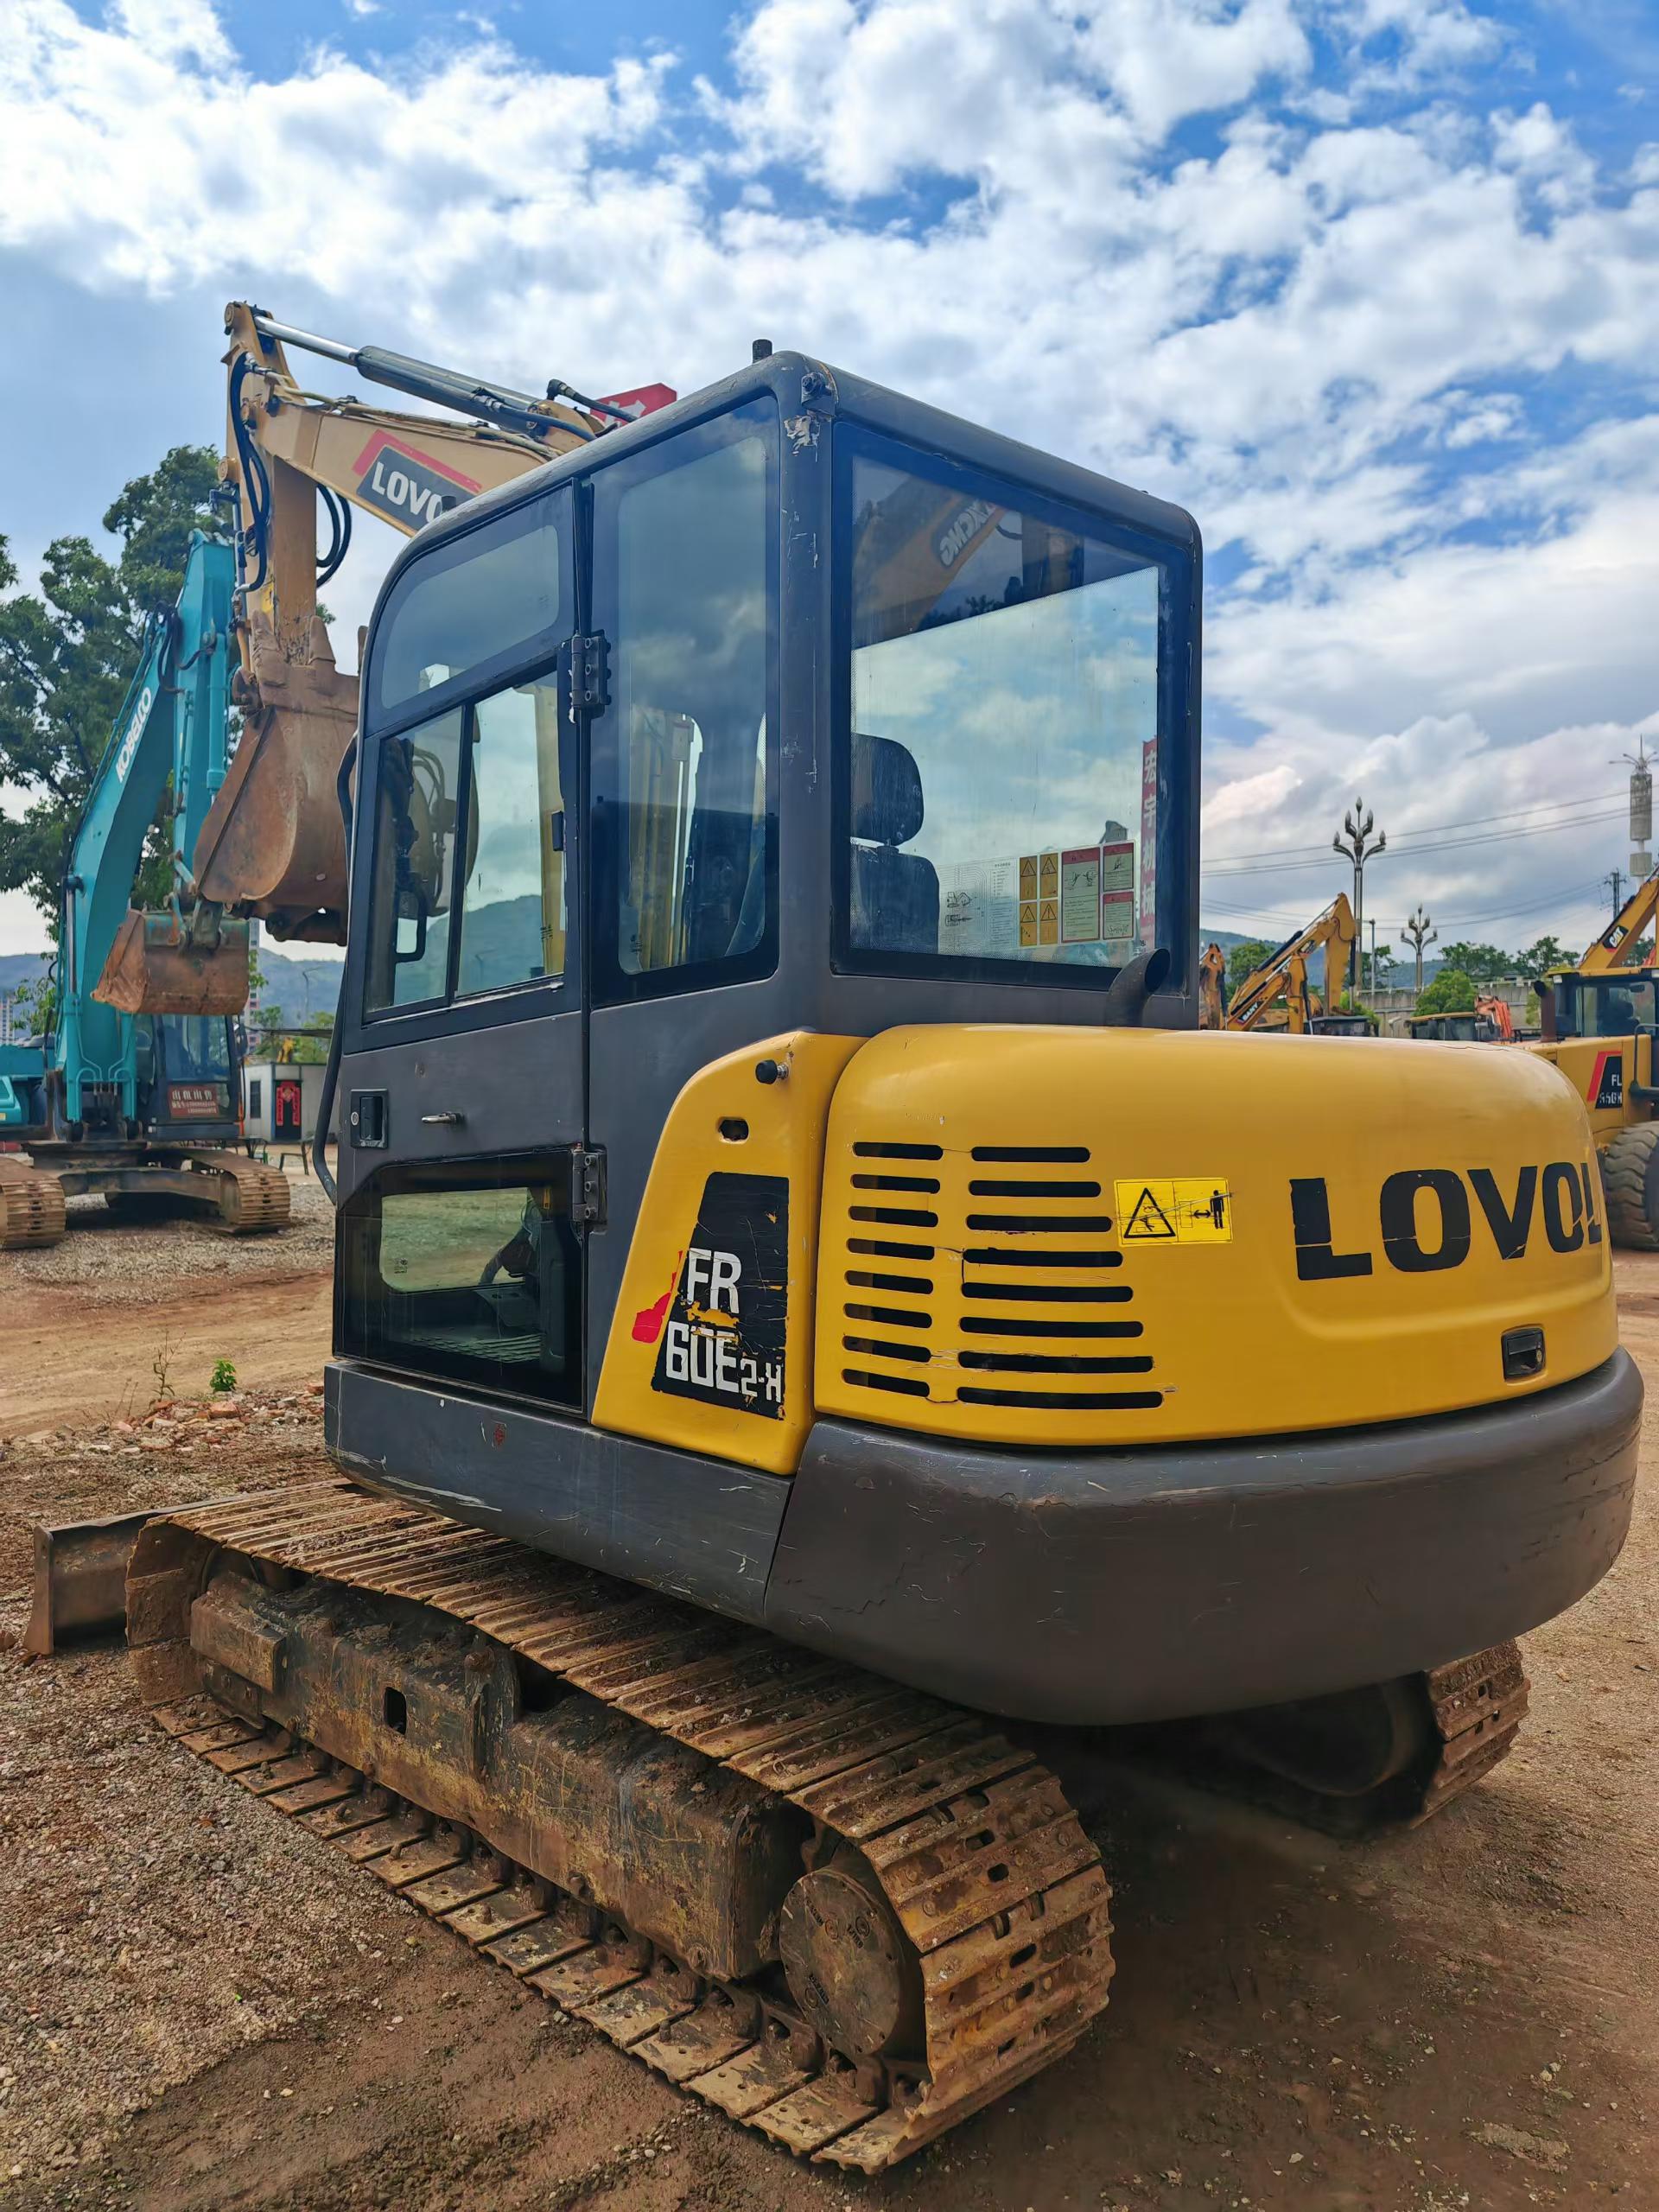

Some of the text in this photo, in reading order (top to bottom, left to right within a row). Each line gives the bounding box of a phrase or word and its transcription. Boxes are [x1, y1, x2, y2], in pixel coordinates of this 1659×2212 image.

[372, 461, 443, 524] LOVO
[116, 687, 151, 783] KOBELCO
[1609, 925, 1624, 948] CAT
[1611, 1074, 1622, 1086] FL
[1289, 1161, 1603, 1281] LOVOL
[686, 1248, 742, 1313] FR
